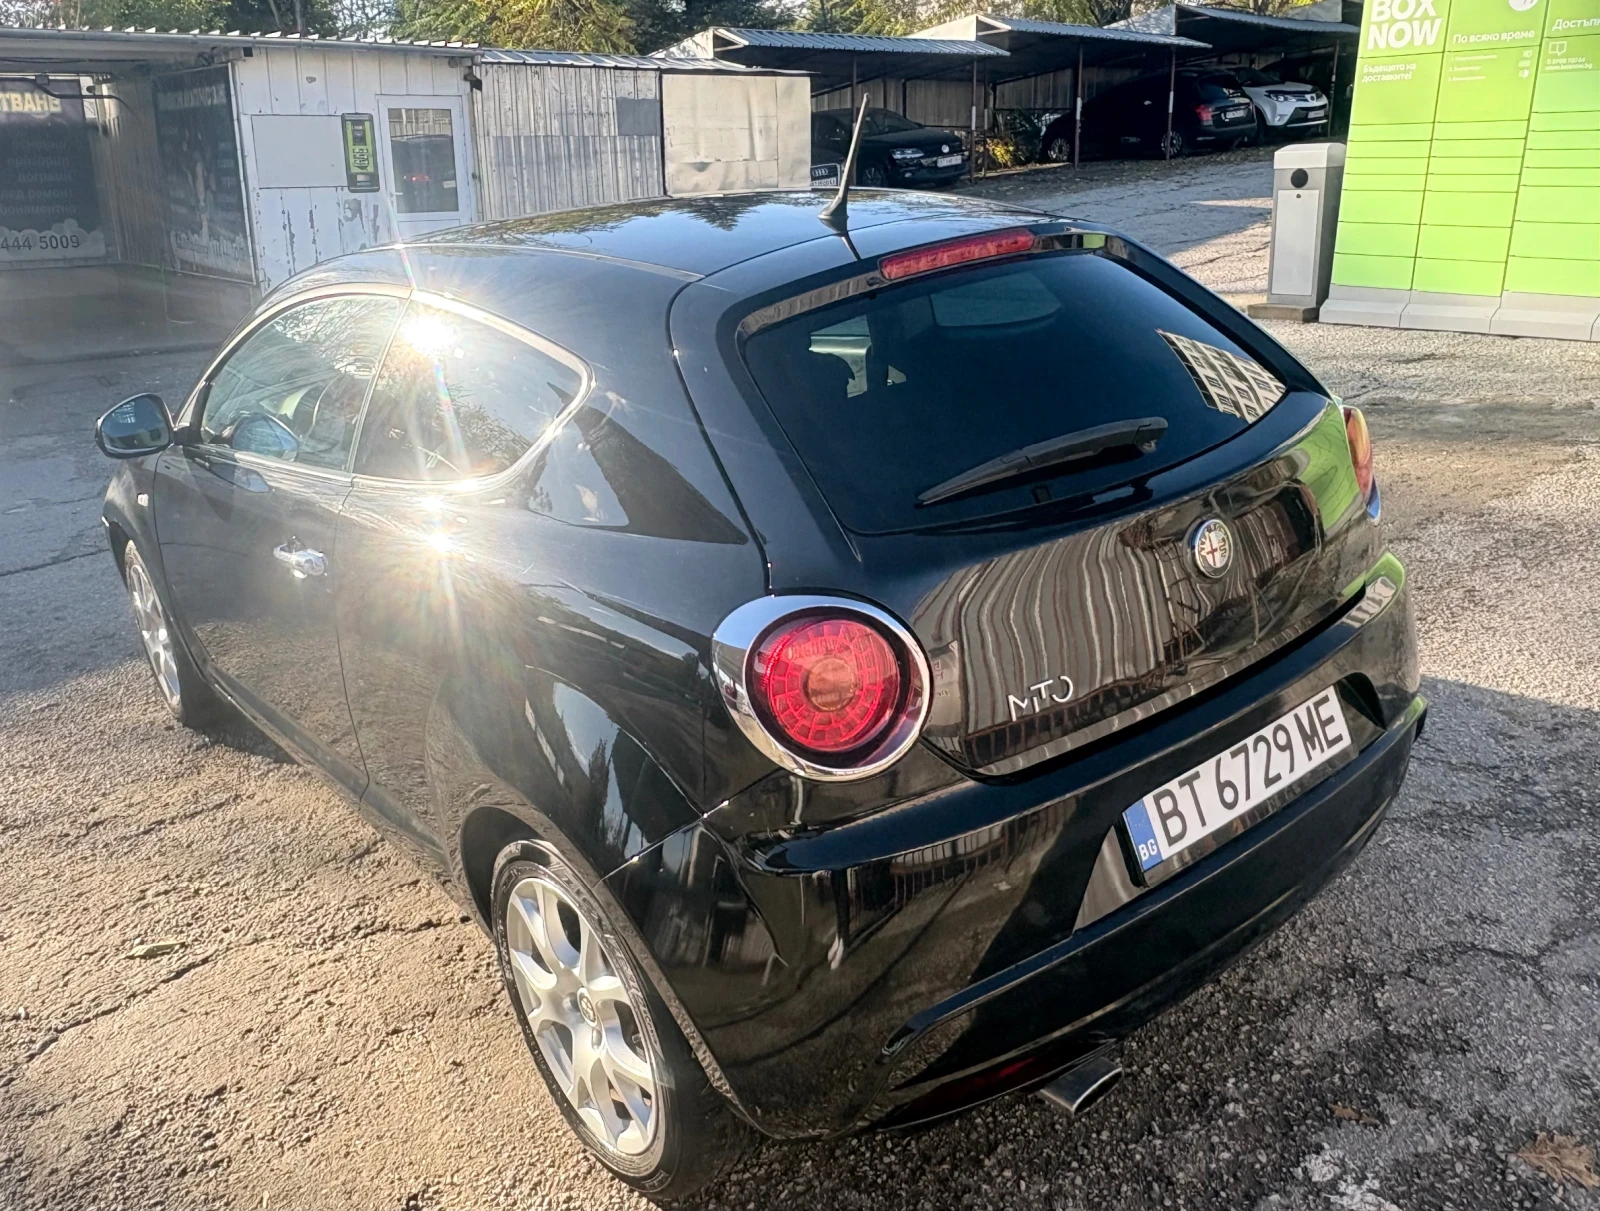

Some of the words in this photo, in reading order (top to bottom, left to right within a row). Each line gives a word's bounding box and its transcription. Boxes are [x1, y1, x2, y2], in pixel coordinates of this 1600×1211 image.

[1370, 0, 1437, 22] BOX
[1366, 18, 1443, 50] NOW
[1453, 34, 1467, 44] По
[1469, 32, 1499, 42] всяко
[1500, 30, 1535, 42] време
[39, 234, 81, 250] 5009
[1152, 771, 1207, 848] BT
[1215, 723, 1295, 811] 6729
[1294, 694, 1344, 762] ME
[1138, 838, 1158, 862] BG
